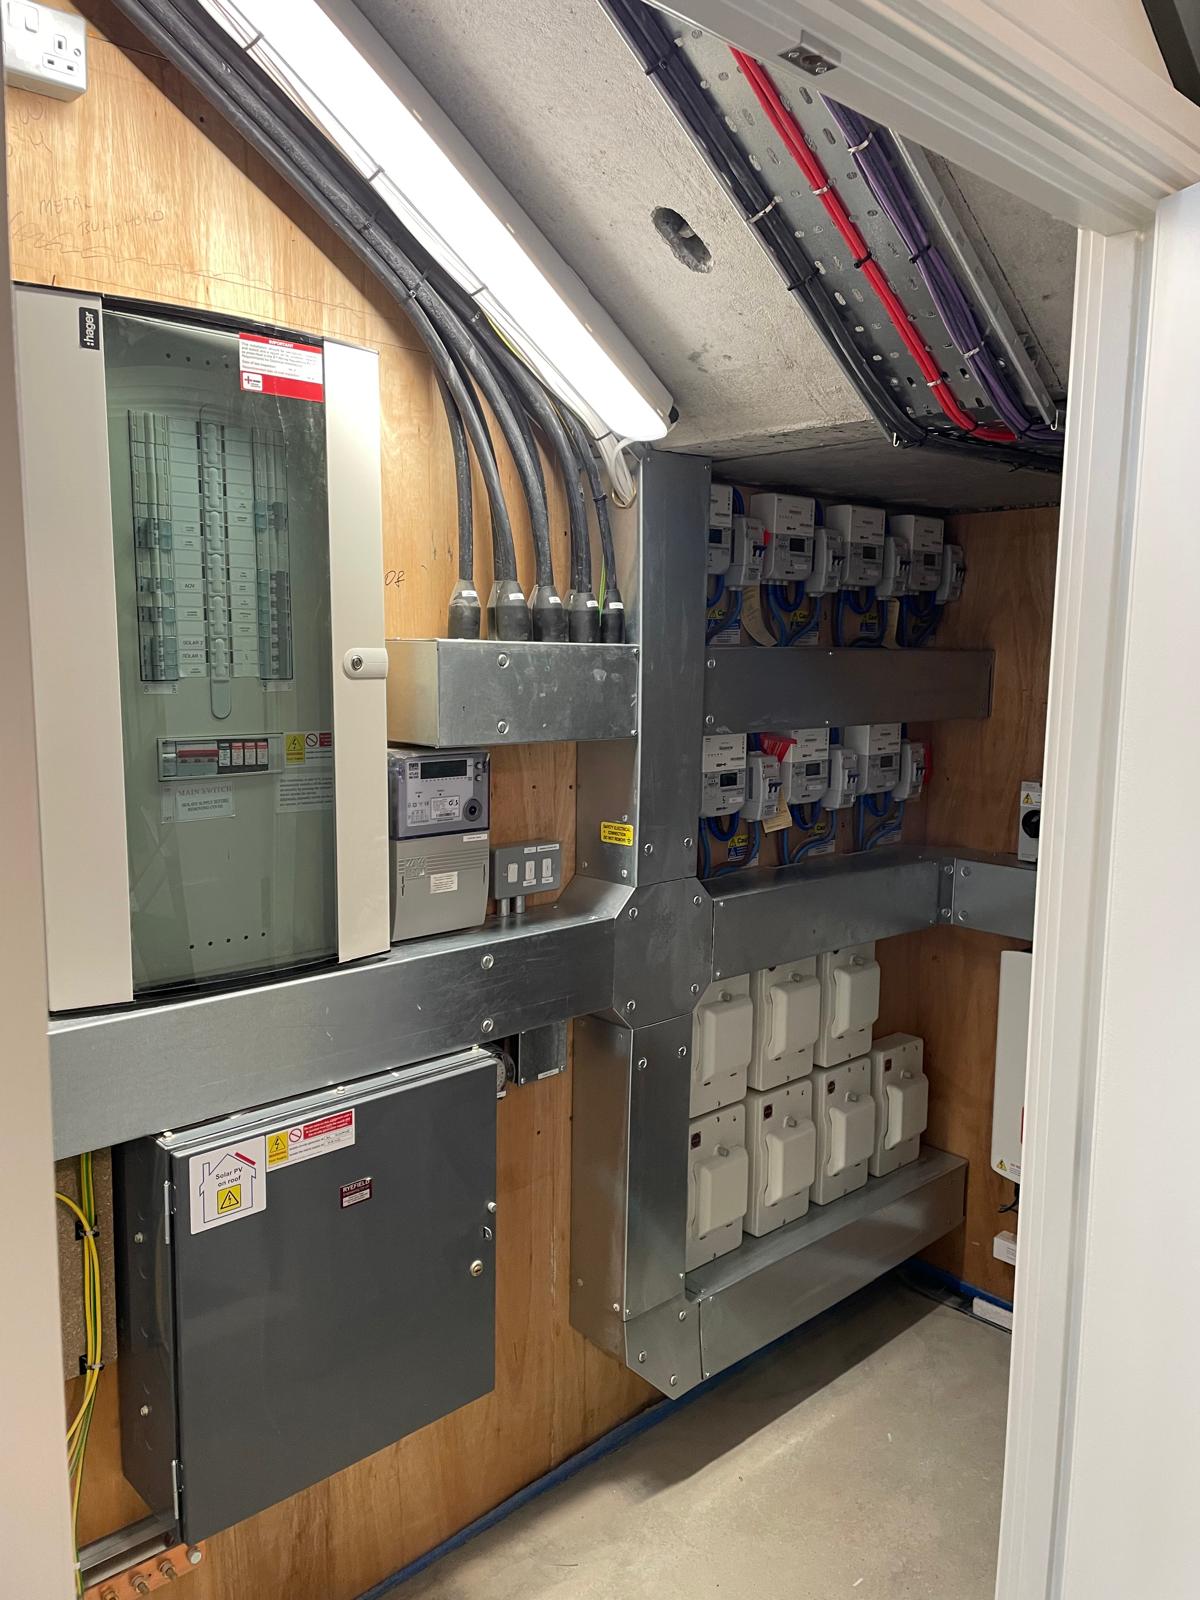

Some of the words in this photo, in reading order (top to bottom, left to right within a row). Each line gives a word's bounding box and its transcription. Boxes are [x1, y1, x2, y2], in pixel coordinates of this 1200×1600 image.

[268, 339, 294, 348] IMPORTANT
[178, 788, 200, 797] MAIN
[201, 784, 232, 794] SWITCH
[215, 1170, 232, 1180] Solar
[233, 1166, 243, 1174] PV
[227, 1175, 241, 1184] roof
